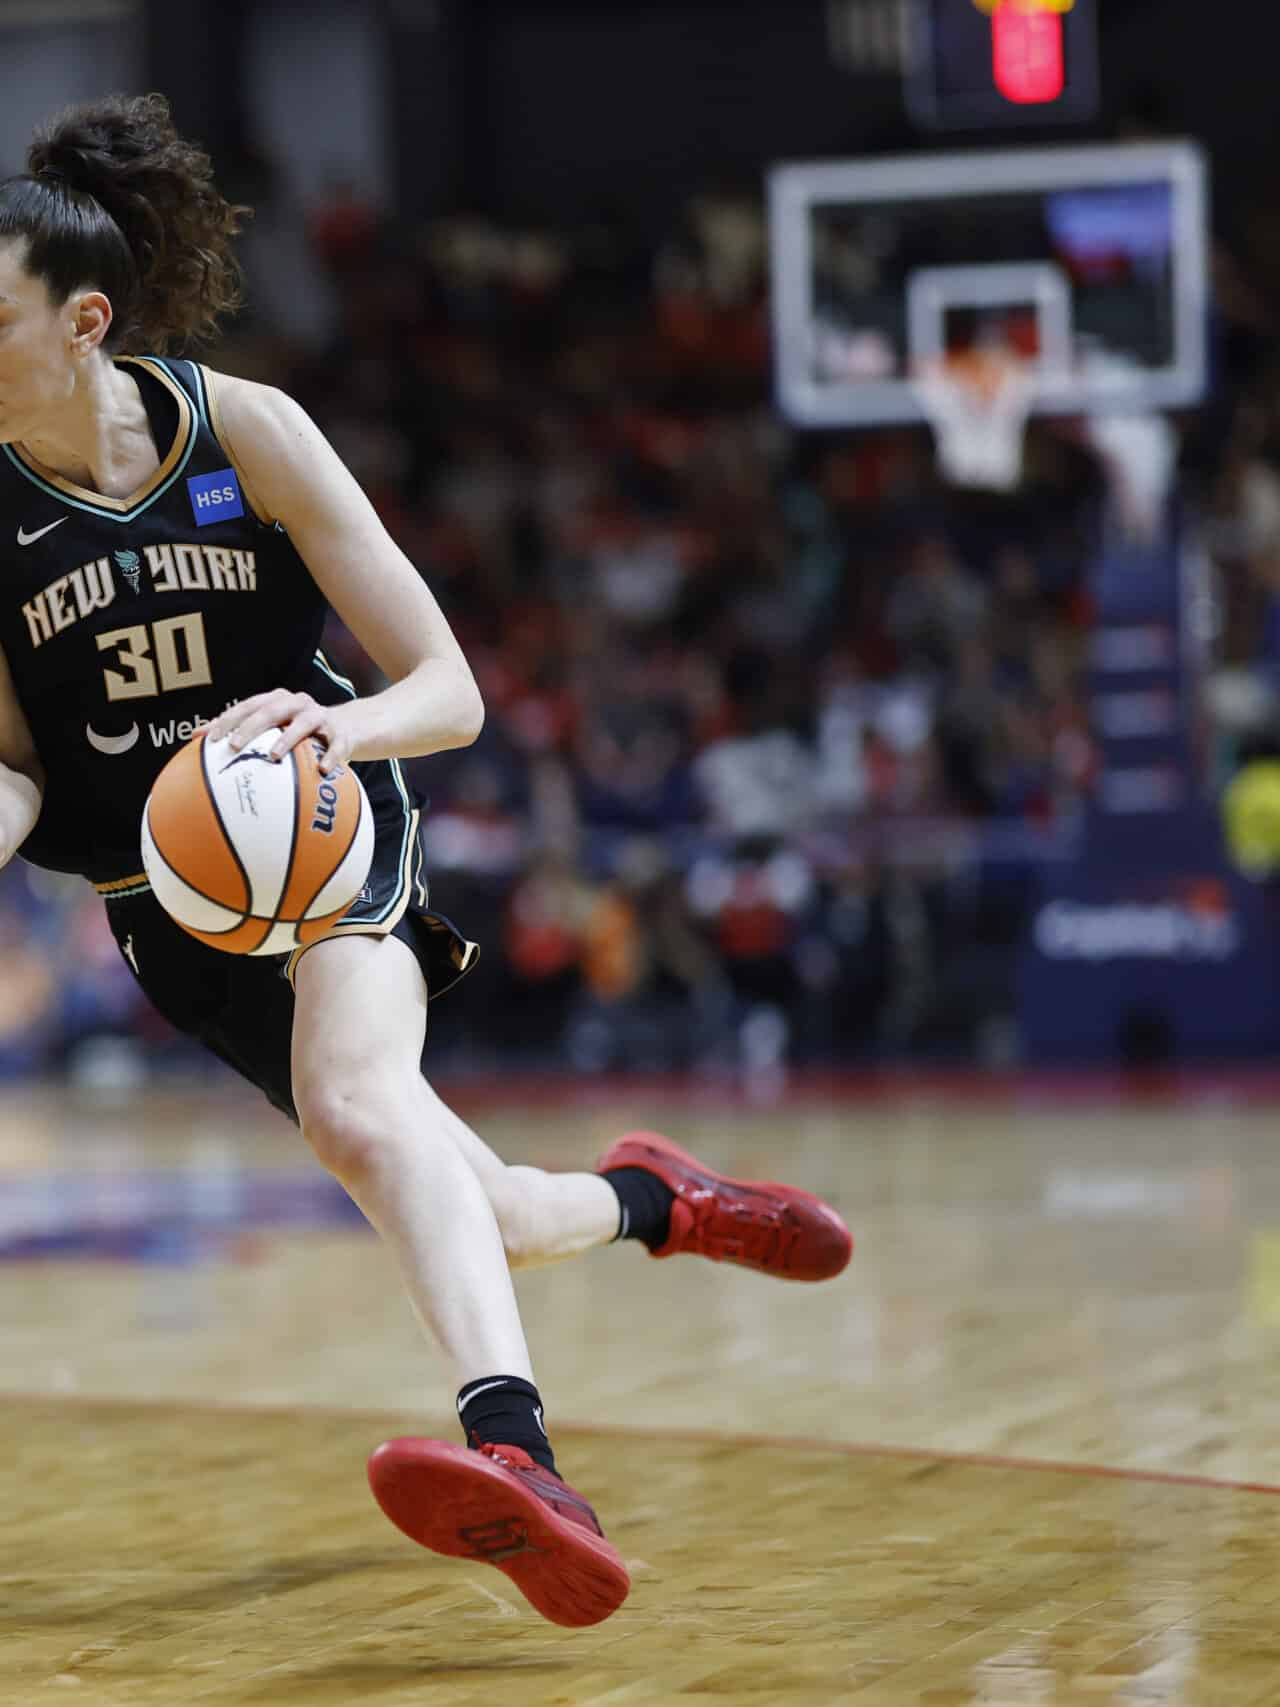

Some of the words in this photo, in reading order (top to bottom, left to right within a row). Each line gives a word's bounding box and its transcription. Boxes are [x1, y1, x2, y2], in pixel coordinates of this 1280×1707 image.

[196, 486, 235, 508] HSS
[21, 556, 117, 649] NEW
[143, 543, 257, 593] YORK
[95, 611, 213, 702] 30
